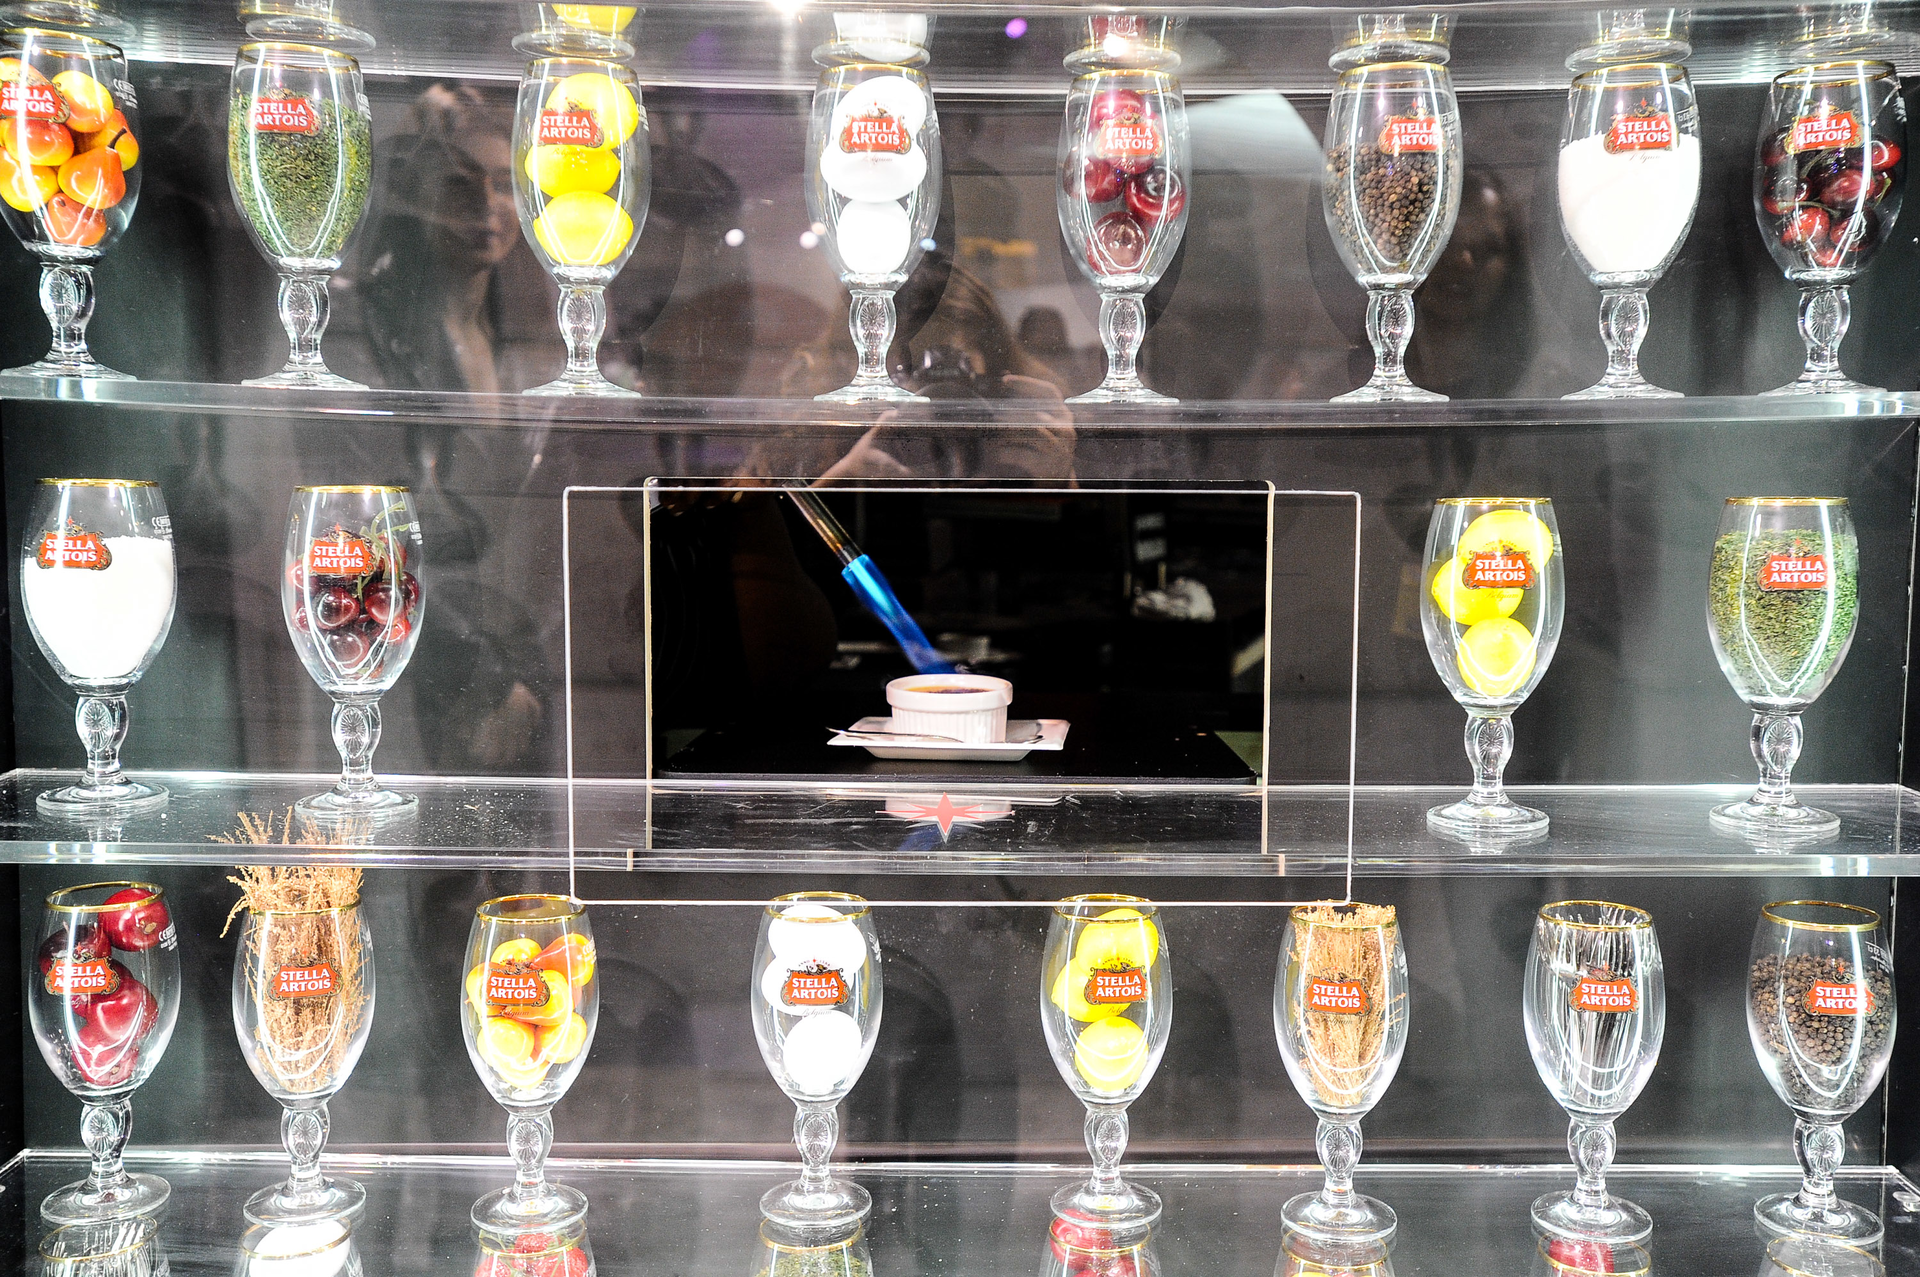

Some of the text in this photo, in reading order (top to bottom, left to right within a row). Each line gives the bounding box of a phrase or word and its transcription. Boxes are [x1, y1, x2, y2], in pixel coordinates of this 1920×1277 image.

[2, 87, 54, 102] STLLA
[256, 102, 306, 115] STELLA
[255, 115, 308, 126] ARTOIS
[542, 115, 590, 128] STELLA
[1618, 119, 1666, 133] STELLA
[1798, 118, 1850, 133] STELLA
[541, 127, 591, 138] ARTOIS
[852, 121, 897, 133] STELLA
[1106, 126, 1152, 138] STELLA
[1392, 122, 1439, 135] STELLA
[851, 133, 900, 145] ARTOIS
[1105, 138, 1154, 148] ARTOIS
[1391, 134, 1441, 145] ARTOIS
[1617, 131, 1670, 144] ARTOIS
[1797, 130, 1851, 144] ARTOIS
[46, 539, 96, 551] SELLA
[313, 545, 363, 557] STELLA
[45, 550, 97, 561] ATOIS
[313, 556, 364, 567] ARTOIS
[1475, 559, 1525, 571] STELLA
[1771, 560, 1824, 572] STELLA
[1474, 570, 1526, 581] ARTOIS
[1770, 571, 1825, 582] ARTOIS
[55, 965, 105, 976] SELLA
[279, 969, 330, 982] STELLA
[279, 980, 331, 992] ARTOIS
[491, 976, 536, 988] STELLA
[792, 978, 838, 988] STELLA
[1096, 976, 1140, 987] STELLA
[489, 987, 537, 998] ARTOIS
[791, 988, 839, 998] ARTOIS
[1095, 986, 1142, 996] ARTOIS
[1312, 984, 1360, 997] STELLA
[1581, 983, 1629, 996] STELLA
[1816, 987, 1866, 998] STELL
[1311, 996, 1361, 1007] ARTOIS
[1580, 994, 1631, 1006] ARTOIS
[1815, 998, 1868, 1009] ARTO
